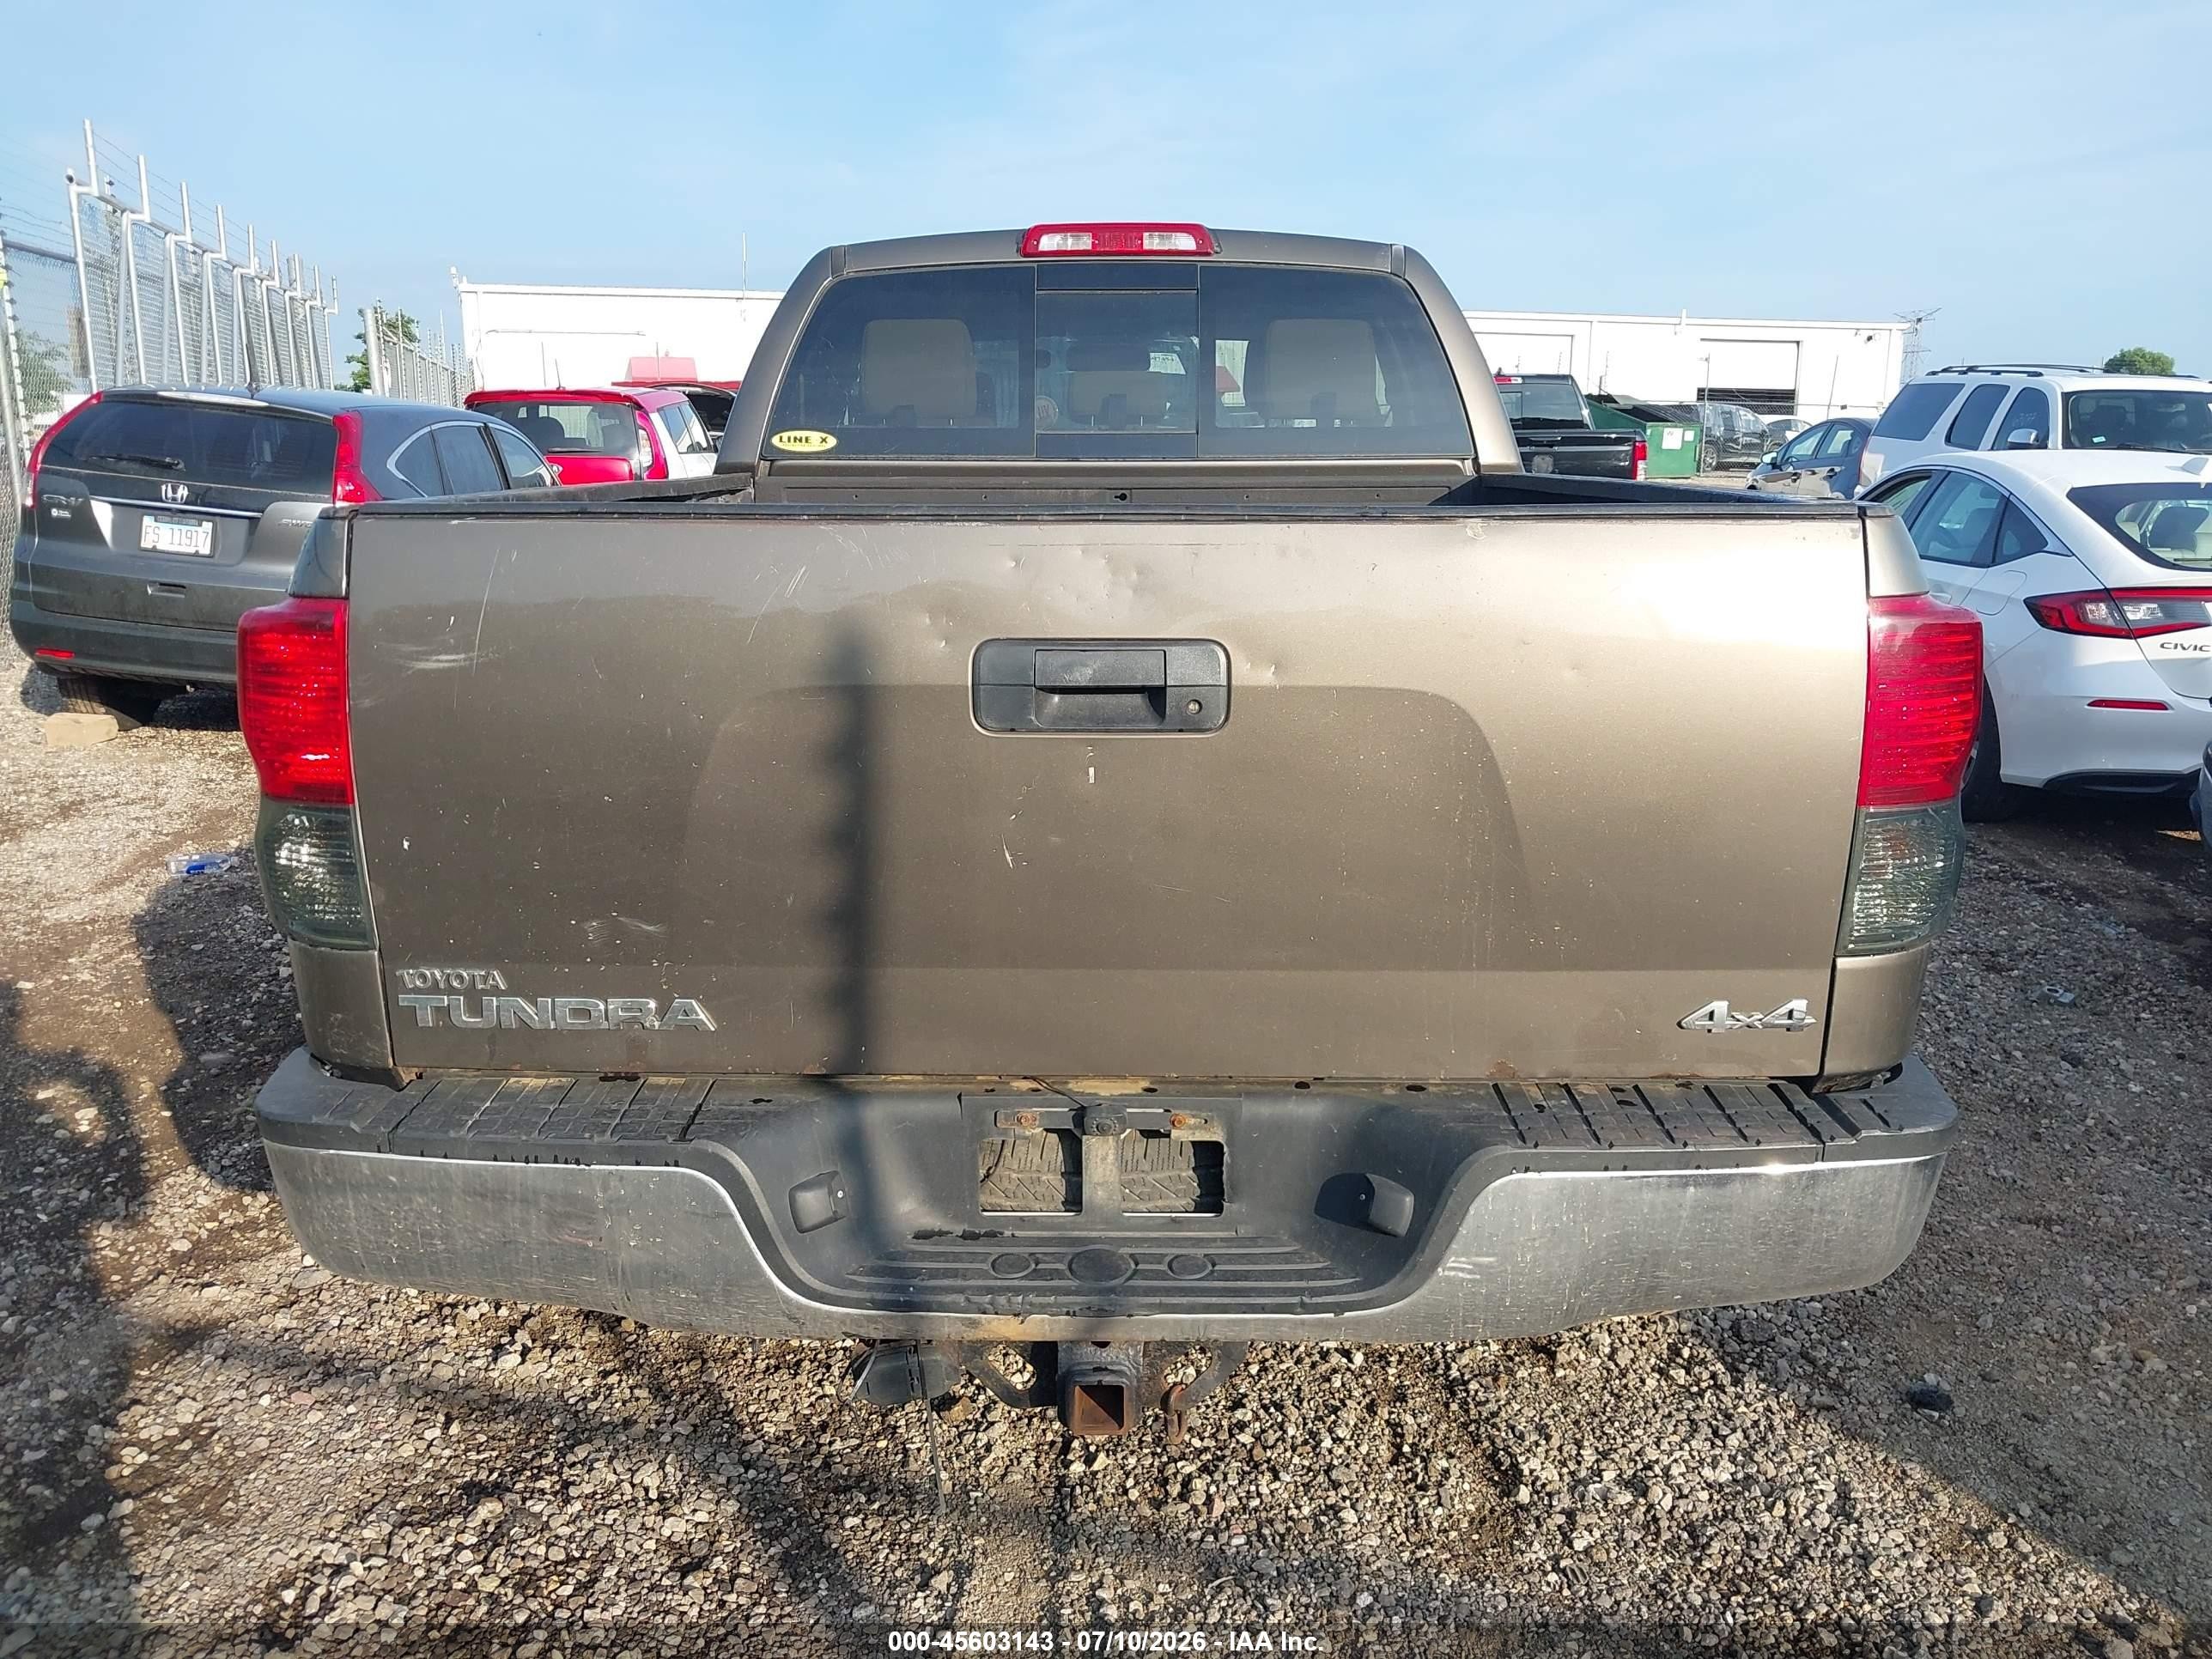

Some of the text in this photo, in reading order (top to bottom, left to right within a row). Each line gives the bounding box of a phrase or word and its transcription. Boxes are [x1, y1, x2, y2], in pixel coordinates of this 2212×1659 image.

[144, 525, 210, 550] FS 11917
[2160, 641, 2211, 653] CIVIC
[395, 969, 508, 990] TOYOTA
[398, 994, 716, 1030] TUNDRA
